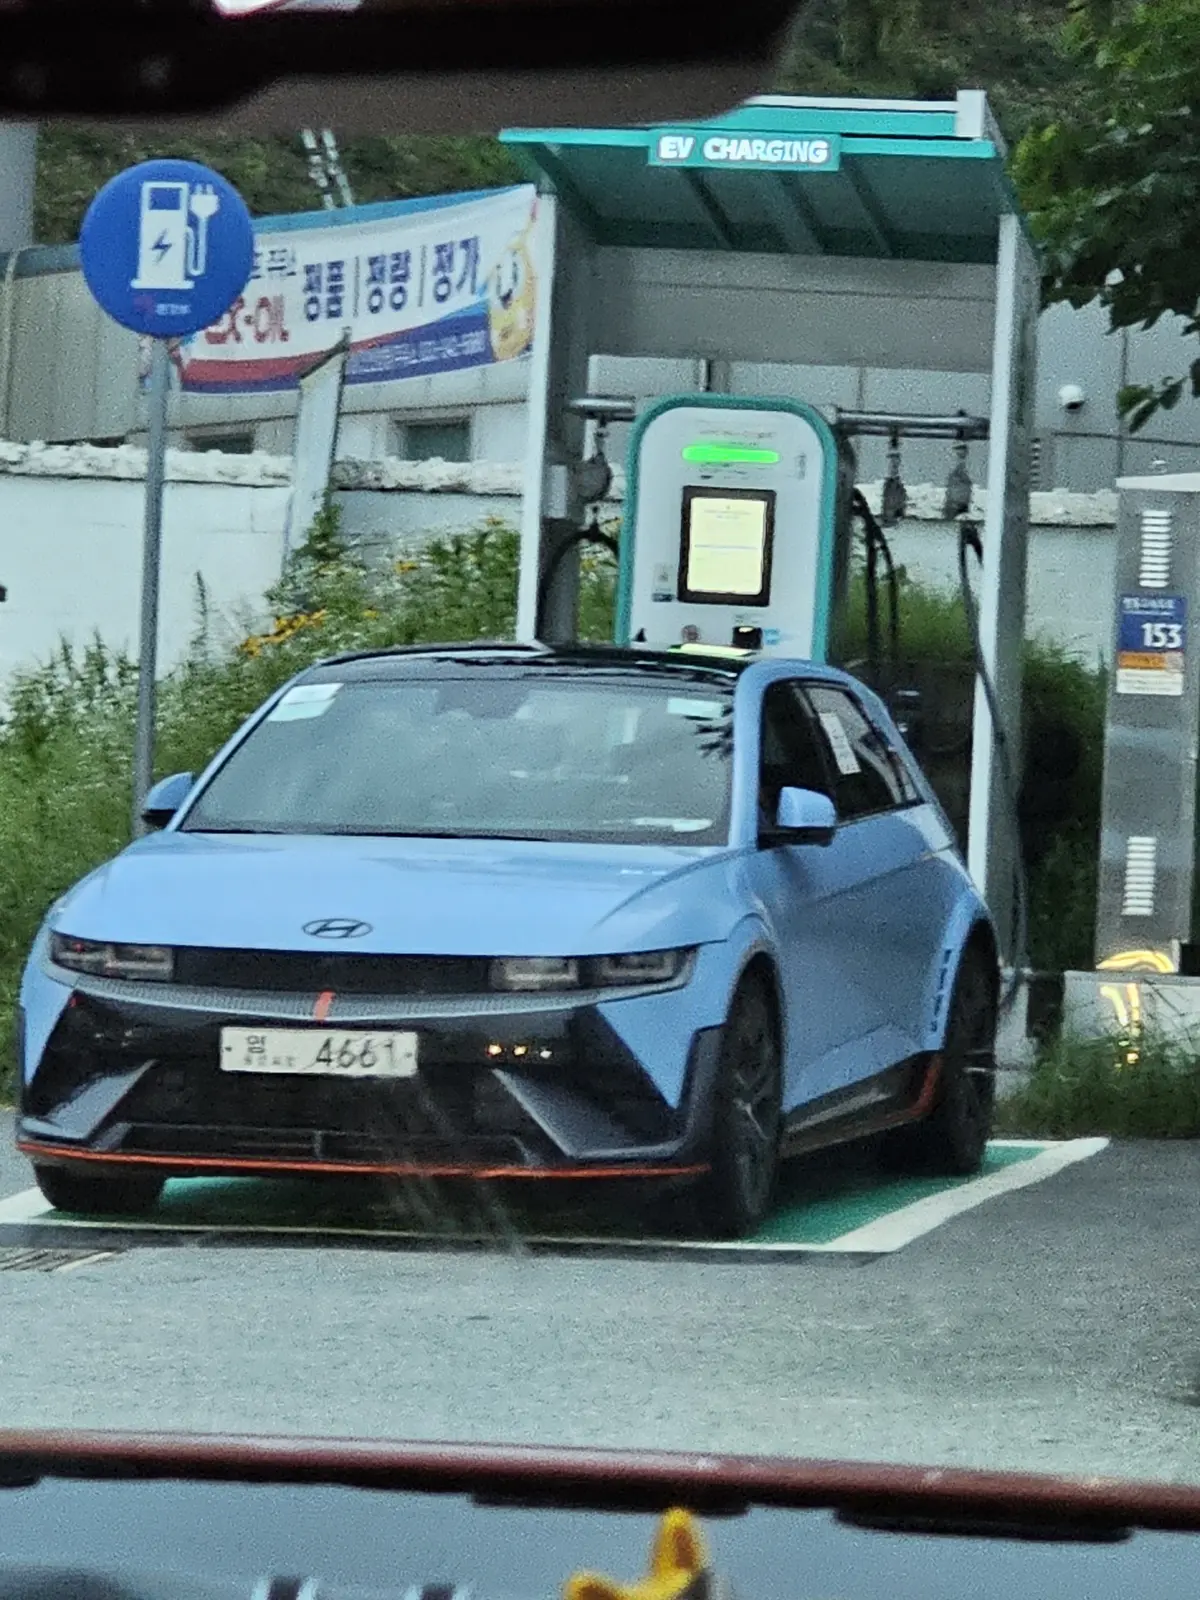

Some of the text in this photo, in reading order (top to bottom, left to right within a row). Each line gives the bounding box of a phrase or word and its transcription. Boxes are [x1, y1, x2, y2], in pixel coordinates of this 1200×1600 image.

[659, 135, 830, 164] EV CHARGING
[1141, 622, 1184, 649] 153
[315, 1036, 396, 1068] 4661
